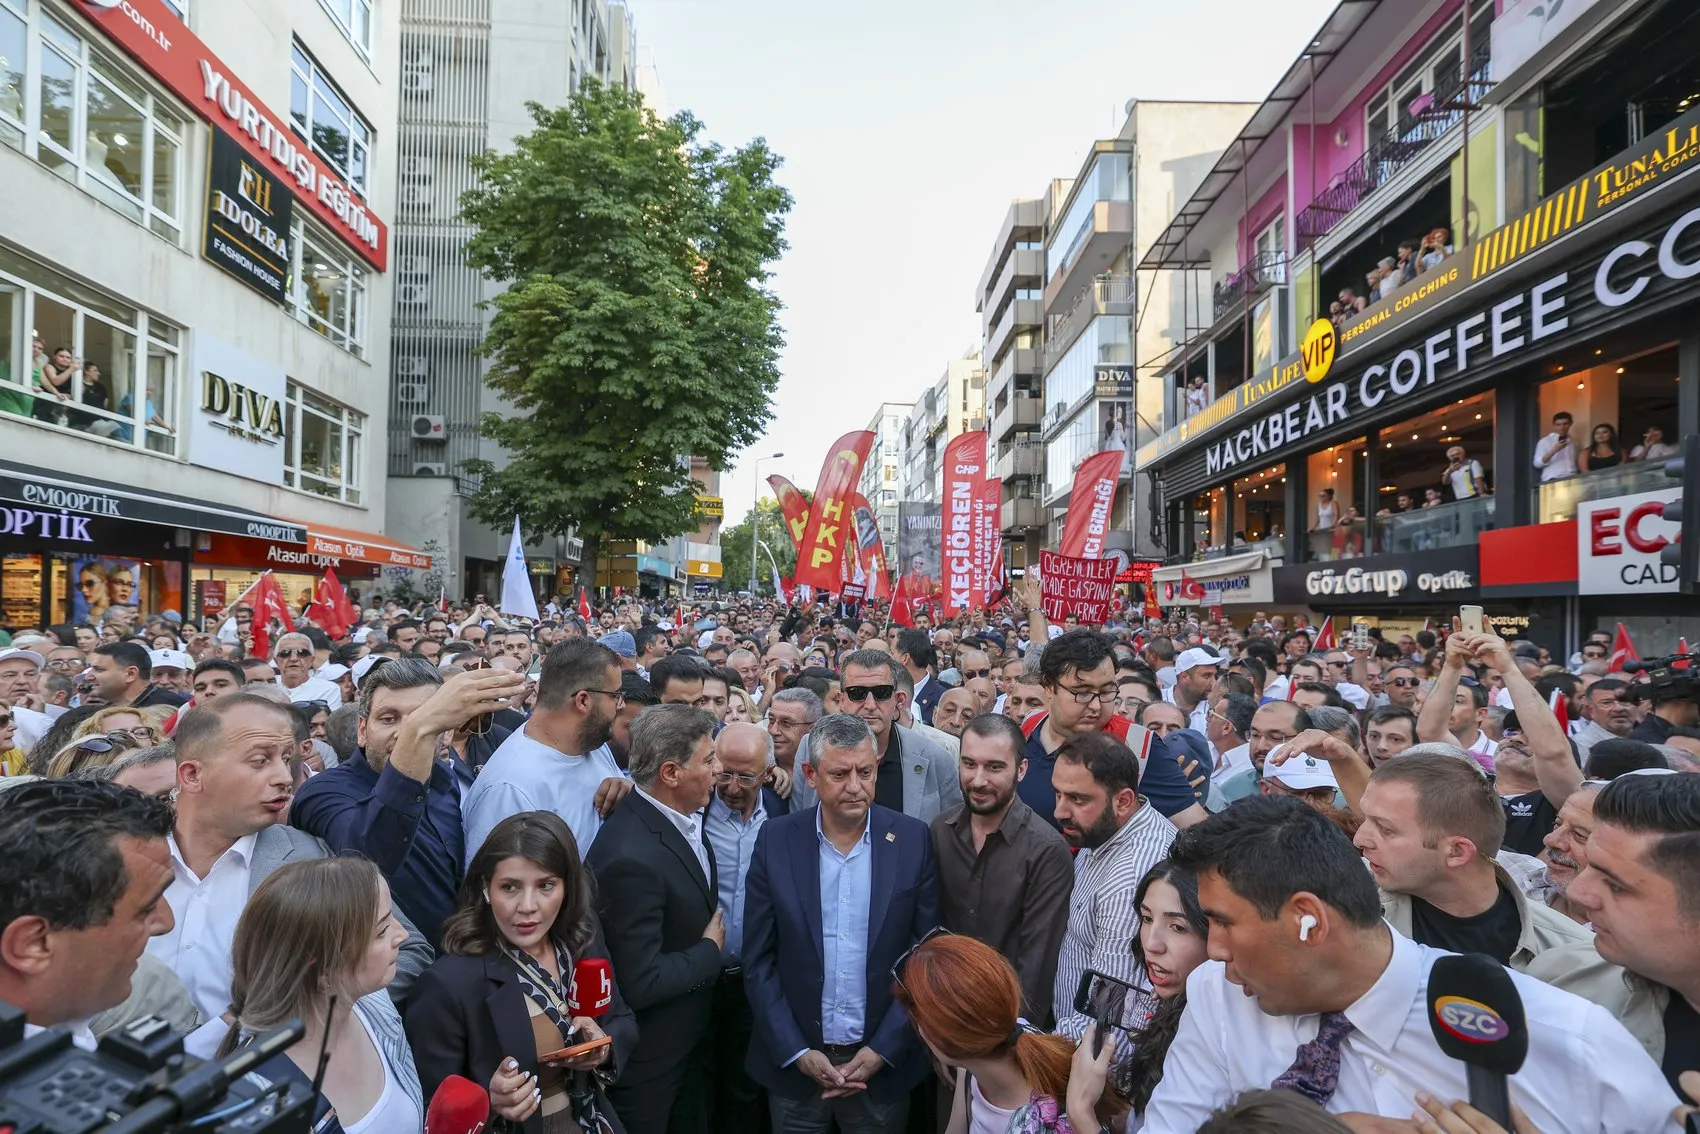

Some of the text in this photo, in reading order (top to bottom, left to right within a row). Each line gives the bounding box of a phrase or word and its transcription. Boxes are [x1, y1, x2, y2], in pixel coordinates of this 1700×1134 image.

[199, 59, 379, 250] YURTDIŞI EĞİTİM
[1597, 145, 1700, 208] PERSONAL COAC
[212, 190, 289, 262] IDOLEA
[213, 237, 281, 291] FASHION HOUSE
[1340, 268, 1458, 344] PERSONAL COACHING
[1206, 382, 1350, 476] MACKBEAR
[1359, 272, 1569, 409] COFFEE
[1302, 331, 1333, 371] VIP
[955, 464, 979, 475] CHP
[907, 515, 942, 529] YANINIZ
[973, 499, 984, 565] BAŞKANLIĞI
[1088, 478, 1113, 536] BİRLİĞİ
[1591, 499, 1682, 556] EC
[267, 545, 310, 564] Atasun
[314, 538, 365, 559] Atasun Optik
[946, 481, 974, 608] KEÇİÖREN
[1306, 567, 1472, 597] GözGrup Optik
[1443, 1005, 1498, 1035] SZC
